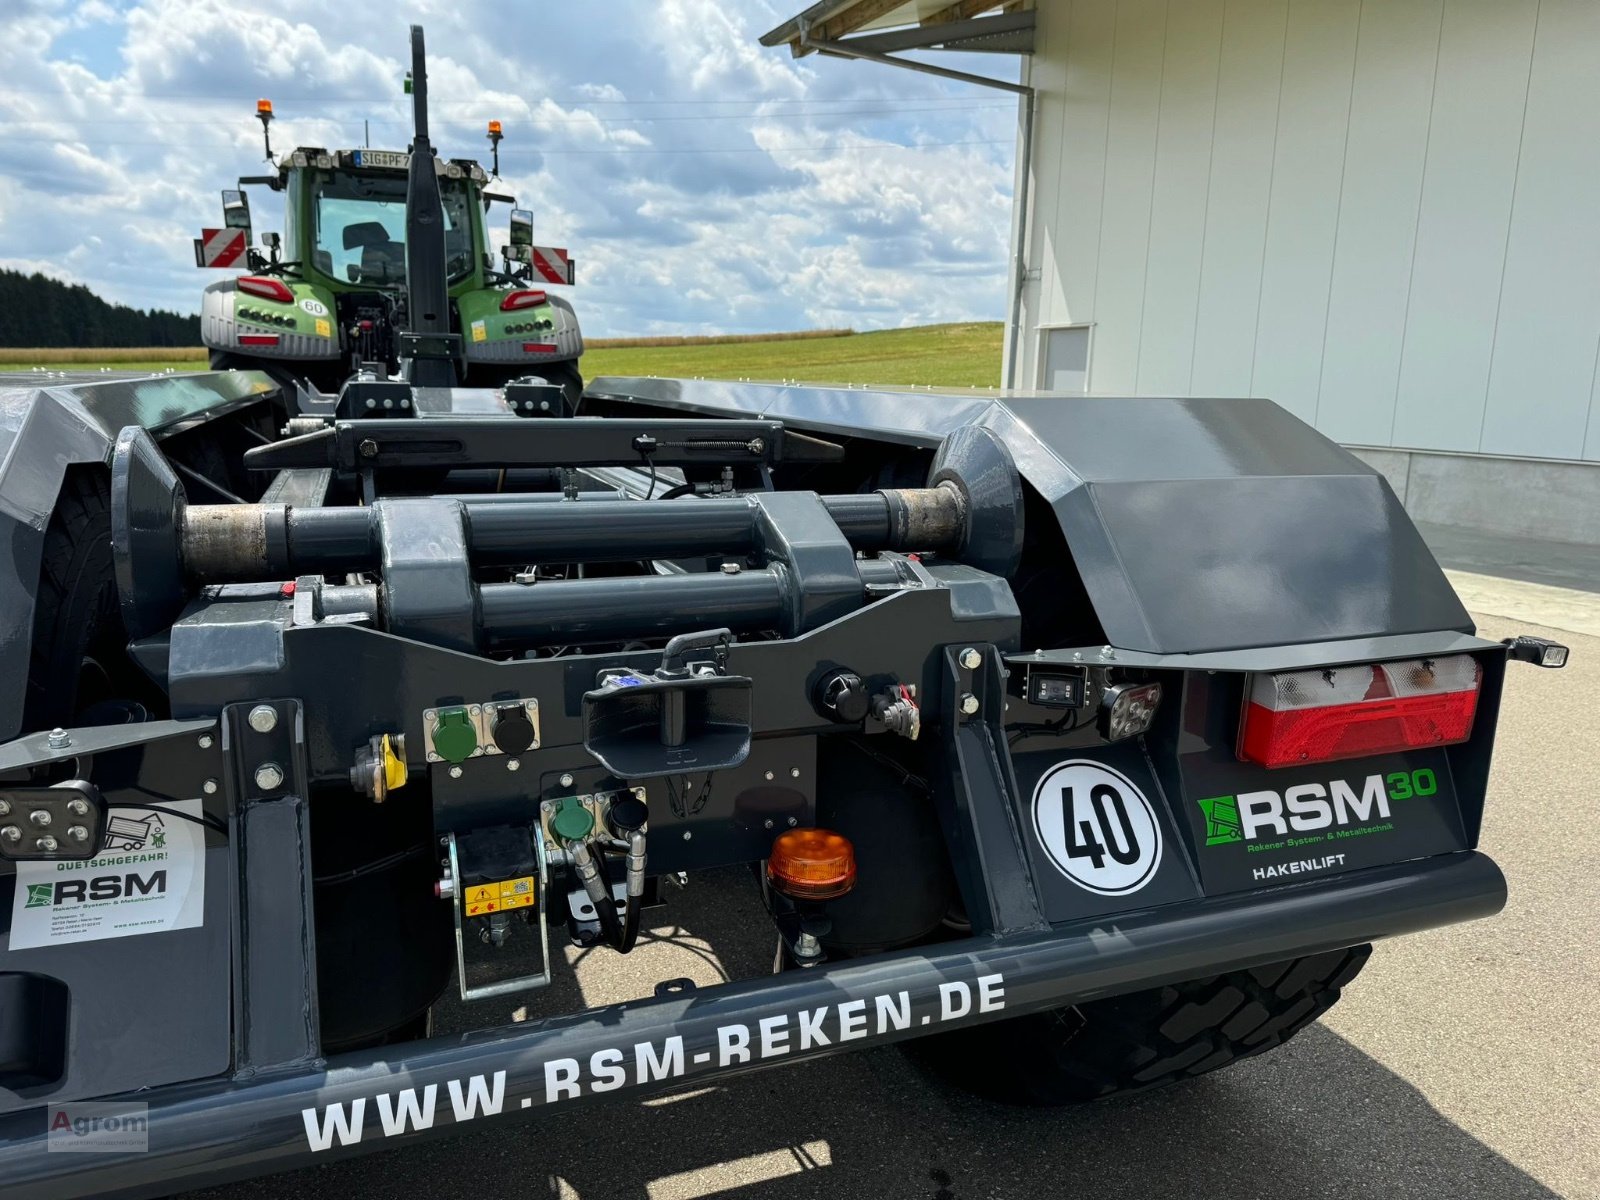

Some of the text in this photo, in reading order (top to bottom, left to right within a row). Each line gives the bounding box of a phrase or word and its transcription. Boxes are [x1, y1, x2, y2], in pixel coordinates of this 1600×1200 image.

[362, 152, 382, 165] SIG
[389, 154, 402, 167] PF
[304, 300, 323, 314] 60
[1236, 768, 1438, 840] RSM 30
[1061, 782, 1141, 870] 40
[1247, 841, 1285, 853] Rekener
[1327, 832, 1334, 840] &
[1336, 822, 1394, 839] Metalltechnik
[57, 852, 169, 871] QUETSCHGEFAHR!
[1253, 853, 1346, 880] HAKENLIFT
[53, 869, 167, 906] RSM
[301, 973, 1006, 1152] WWW.RSM-REKEN.DE
